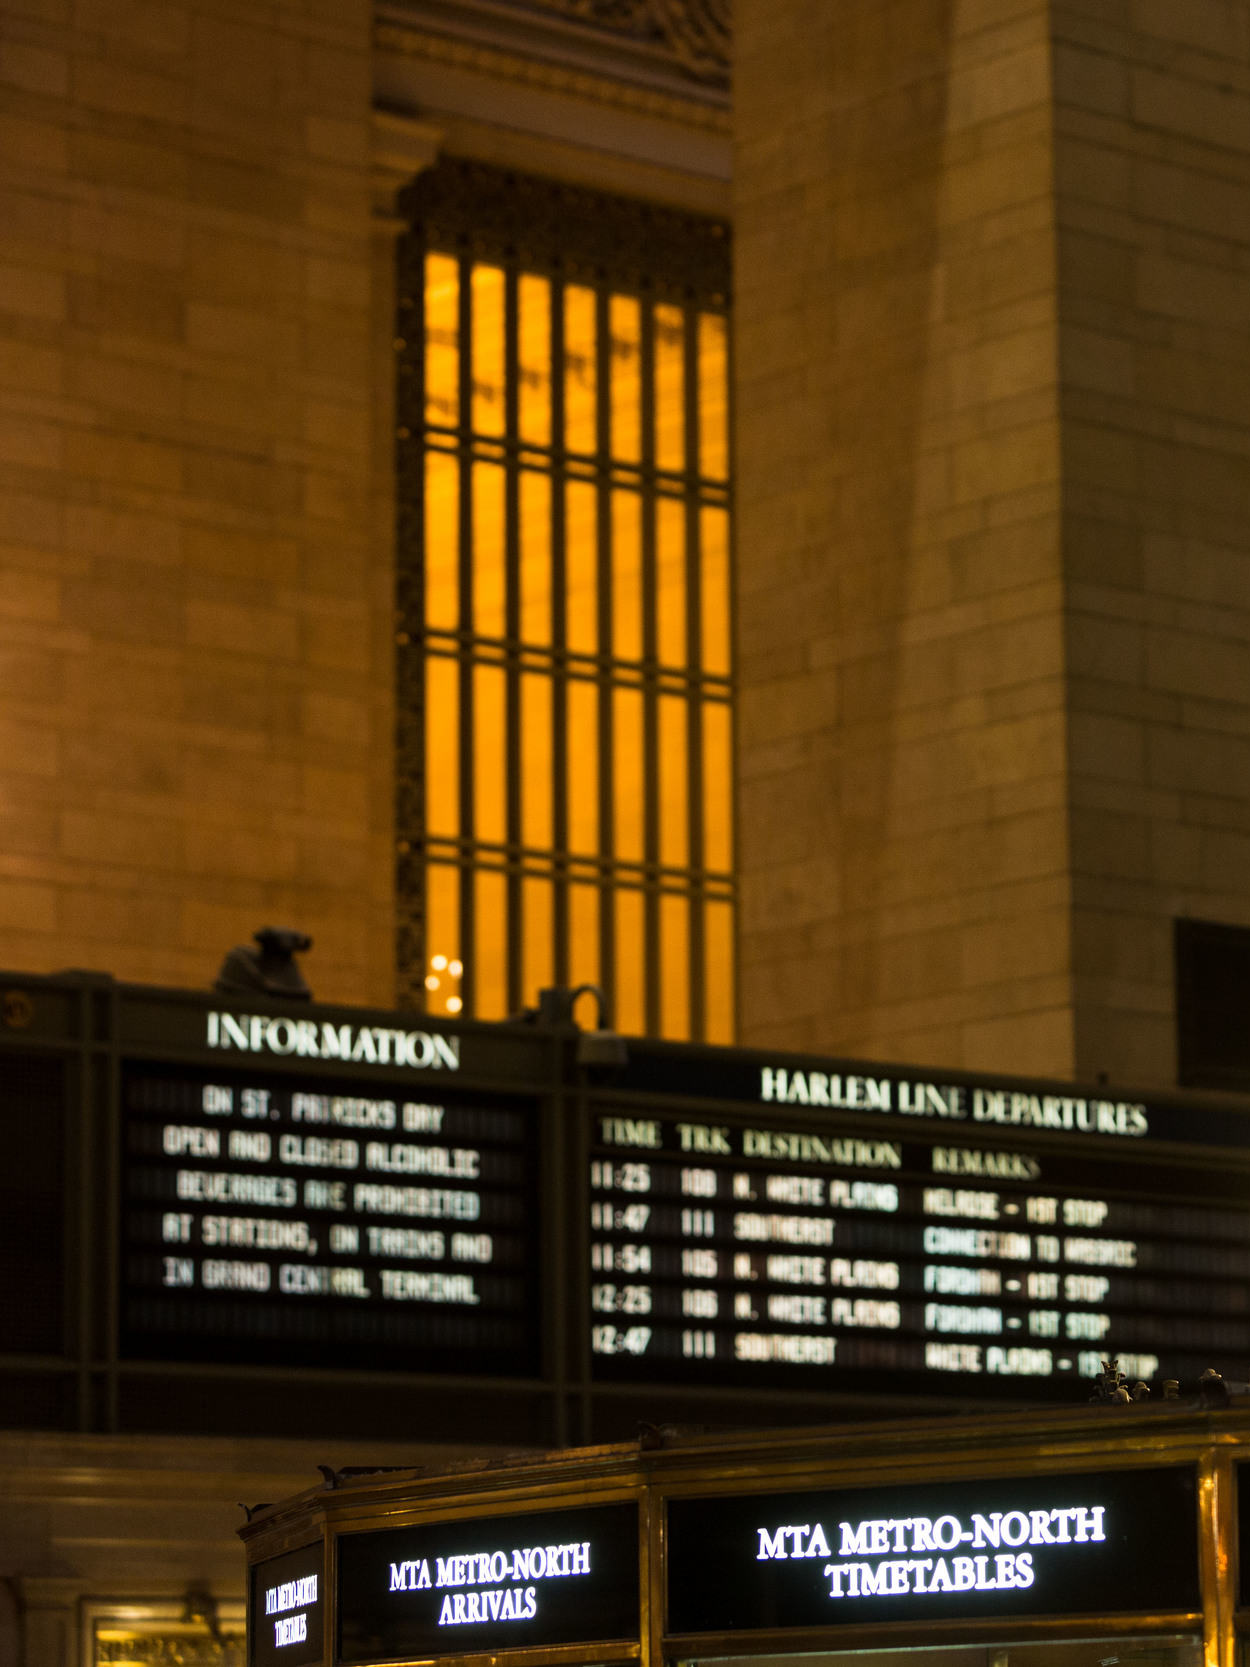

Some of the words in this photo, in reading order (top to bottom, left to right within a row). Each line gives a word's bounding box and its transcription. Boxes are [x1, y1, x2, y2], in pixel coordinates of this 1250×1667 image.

[207, 1011, 460, 1070] INFORMATION
[202, 1085, 233, 1115] ON
[241, 1088, 280, 1120] ST.
[402, 1102, 445, 1134] DAY
[760, 1066, 892, 1113] HARLEM
[898, 1081, 968, 1120] LINE
[972, 1088, 1149, 1137] DEPARTURES
[163, 1125, 220, 1158] OPEN
[229, 1130, 271, 1162] AND
[279, 1134, 359, 1169] CLOSED
[365, 1141, 480, 1179] ALCOHOLIC
[601, 1117, 662, 1149] TIME
[677, 1123, 731, 1155] TRK
[742, 1129, 902, 1169] DESTINATION
[932, 1146, 1042, 1181] REMARKS
[176, 1169, 297, 1207] BEVERAGES
[304, 1179, 347, 1211] ARE
[354, 1182, 480, 1220] PROHIBITED
[591, 1161, 651, 1193] 11:25
[766, 1175, 825, 1207] WHITE
[829, 1179, 899, 1213] PLAINS
[923, 1187, 1000, 1221] MELROSE
[1026, 1196, 1058, 1225] 1ST
[1063, 1198, 1108, 1228] STOP
[162, 1212, 193, 1243] AT
[329, 1224, 359, 1254] ON
[367, 1226, 445, 1259] TRAINS
[451, 1232, 493, 1264] AND
[591, 1202, 651, 1233] 11:47
[733, 1212, 836, 1247] SOUTHEAST
[923, 1226, 1032, 1261] CONNECTION
[1036, 1235, 1060, 1263] TO
[162, 1257, 194, 1287] IN
[202, 1259, 271, 1292] GRAND
[279, 1264, 371, 1298] CENTRAL
[379, 1269, 480, 1305] TERMINAL
[591, 1243, 652, 1274] 11:54
[766, 1254, 826, 1286] WHITE
[830, 1257, 900, 1290] PLAINS
[1027, 1272, 1060, 1300] 1ST
[1064, 1274, 1110, 1303] STOP
[592, 1283, 652, 1315] 12:25
[767, 1294, 827, 1326] WHITE
[831, 1297, 900, 1330] PLAINS
[1028, 1309, 1061, 1338] 1ST
[1065, 1311, 1111, 1341] STOP
[592, 1324, 652, 1356] 12:47
[734, 1332, 838, 1366] SOUTHEAST
[925, 1342, 983, 1373] WHITE
[986, 1345, 1053, 1376] PLAINS
[756, 1523, 831, 1560] MTA
[838, 1506, 1106, 1555] METRO-NORTH
[389, 1559, 432, 1591] MTA
[435, 1542, 591, 1587] METRO-NORTH
[824, 1552, 1035, 1598] TIMETABLES
[438, 1586, 537, 1626] ARRIVALS
